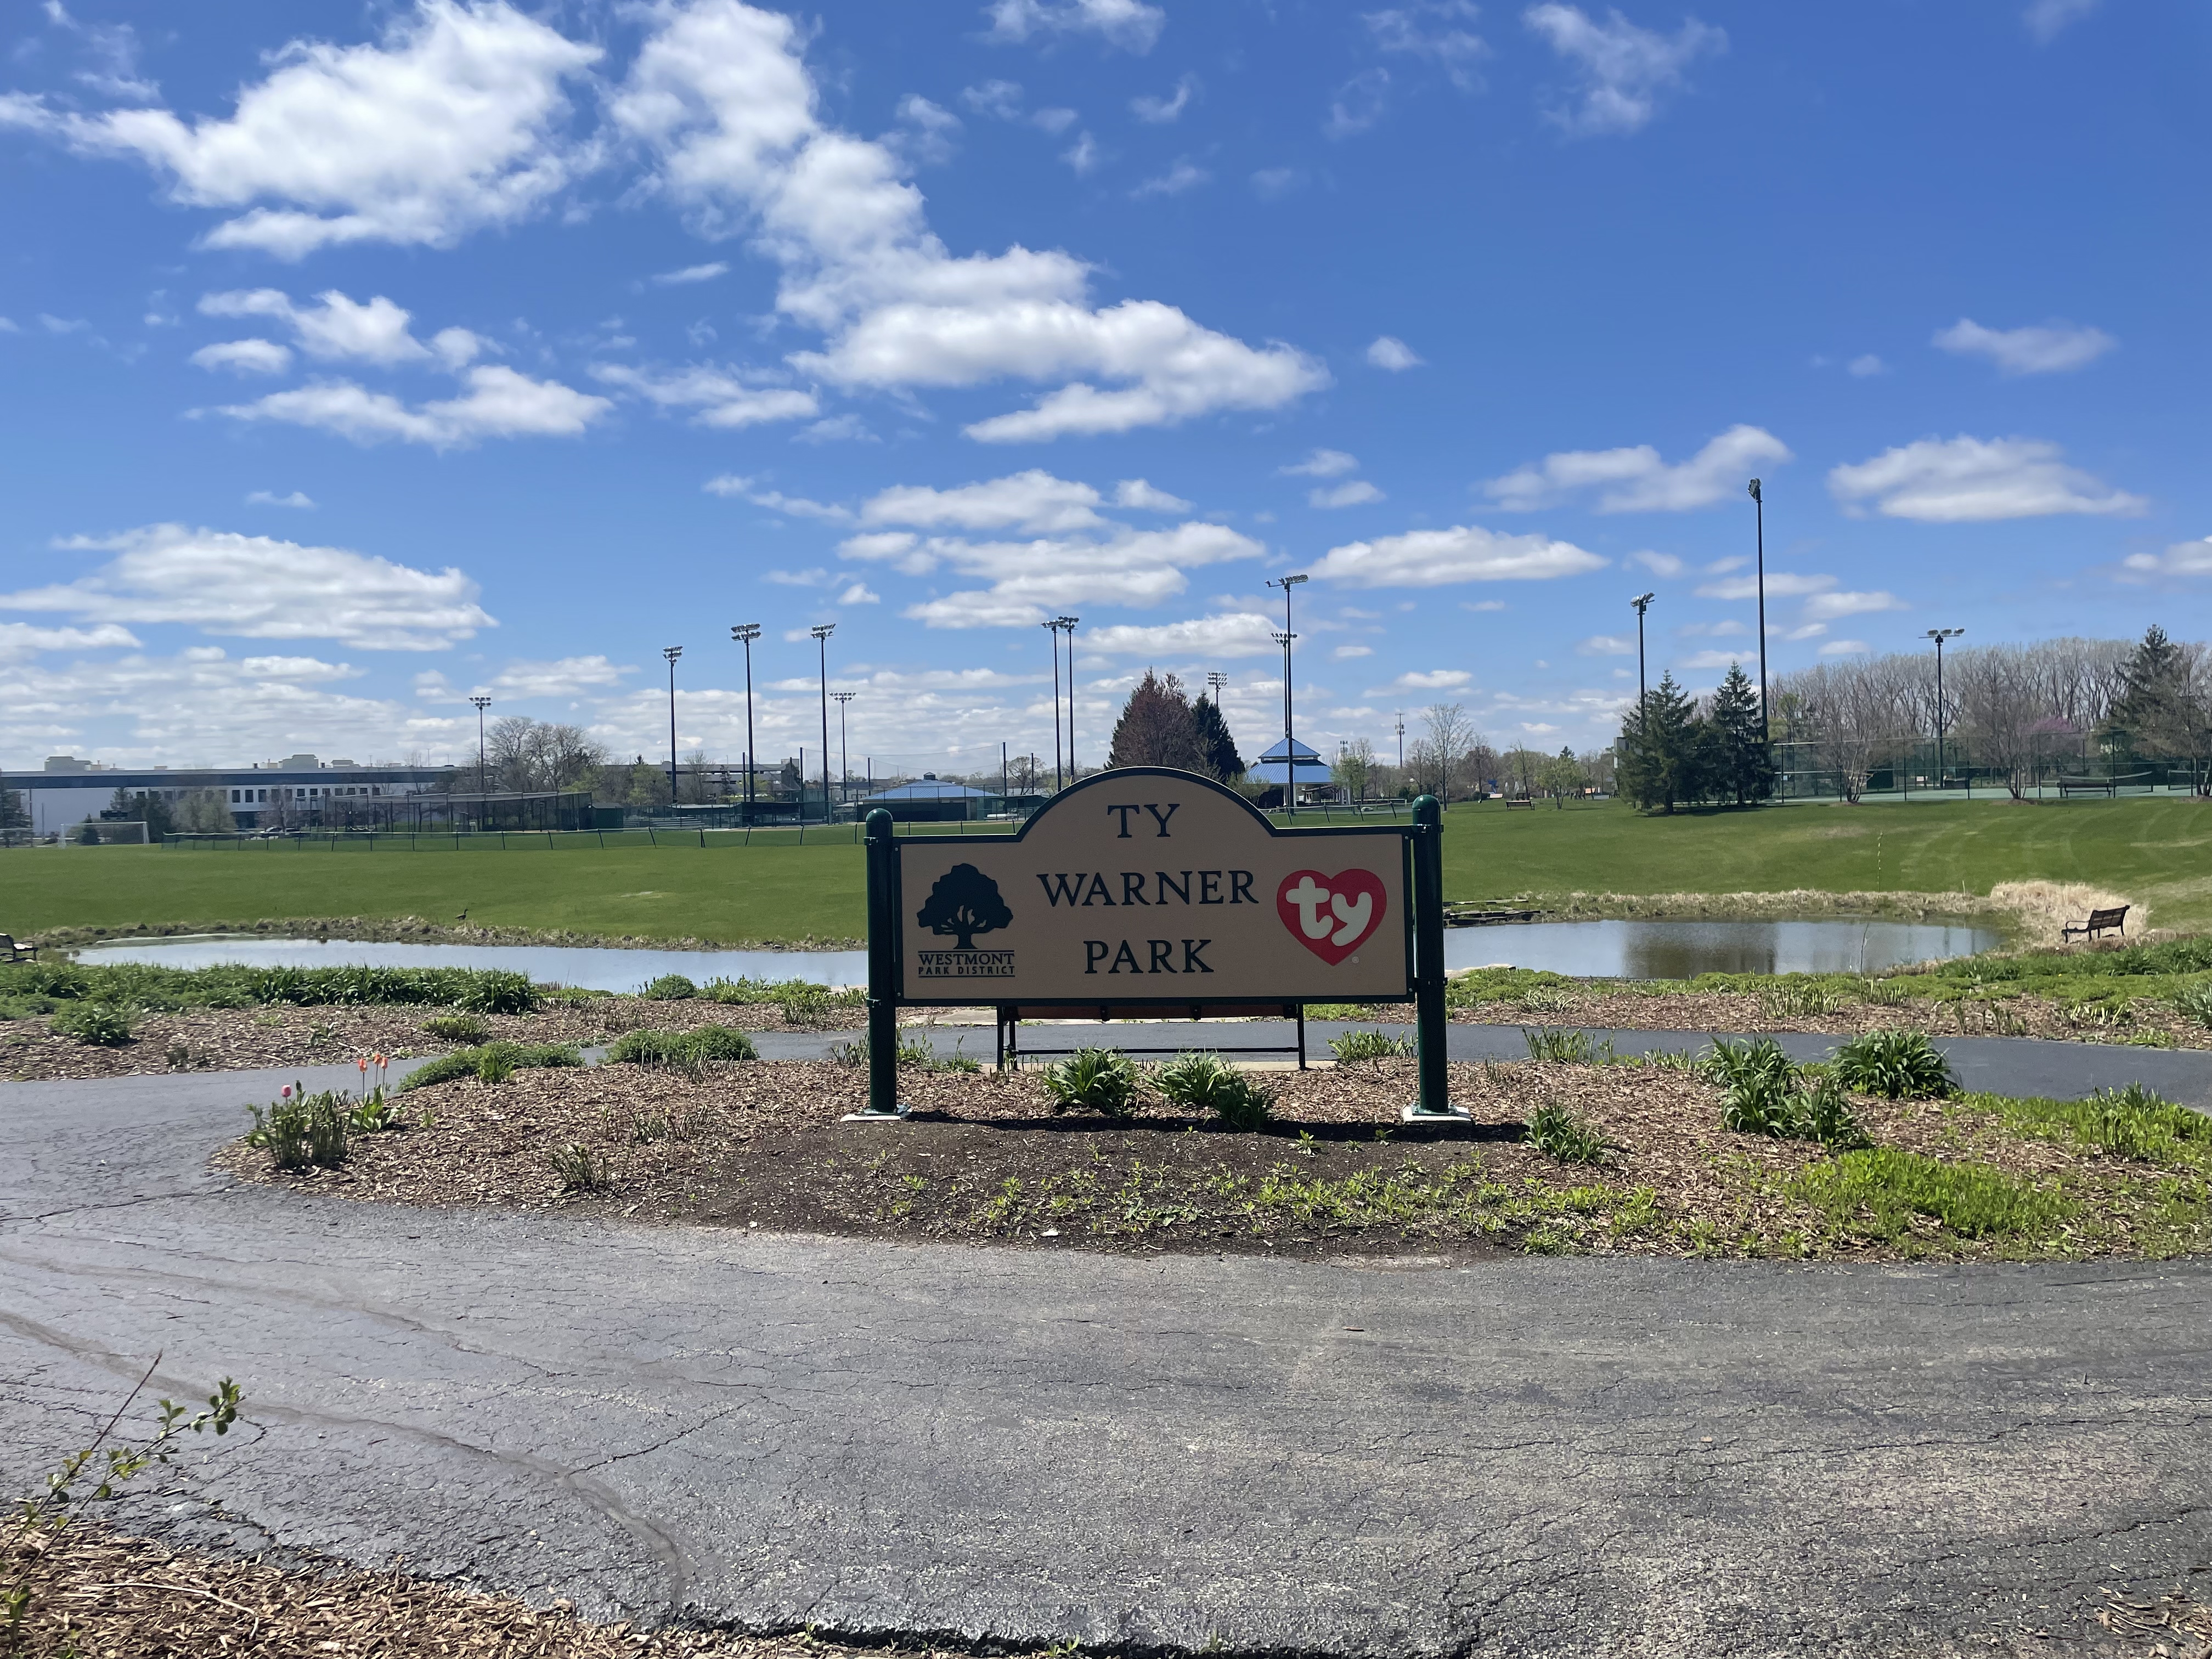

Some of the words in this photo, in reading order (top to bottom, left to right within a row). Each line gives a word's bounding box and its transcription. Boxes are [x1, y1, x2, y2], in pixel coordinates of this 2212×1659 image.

[1107, 803, 1181, 838] TY
[1036, 870, 1260, 907] WARNER
[1285, 876, 1373, 947] ty
[918, 953, 1015, 966] WESTMONT
[918, 966, 950, 975] PARK
[957, 966, 1015, 975] DISTRICT
[1083, 939, 1215, 974] PARK
